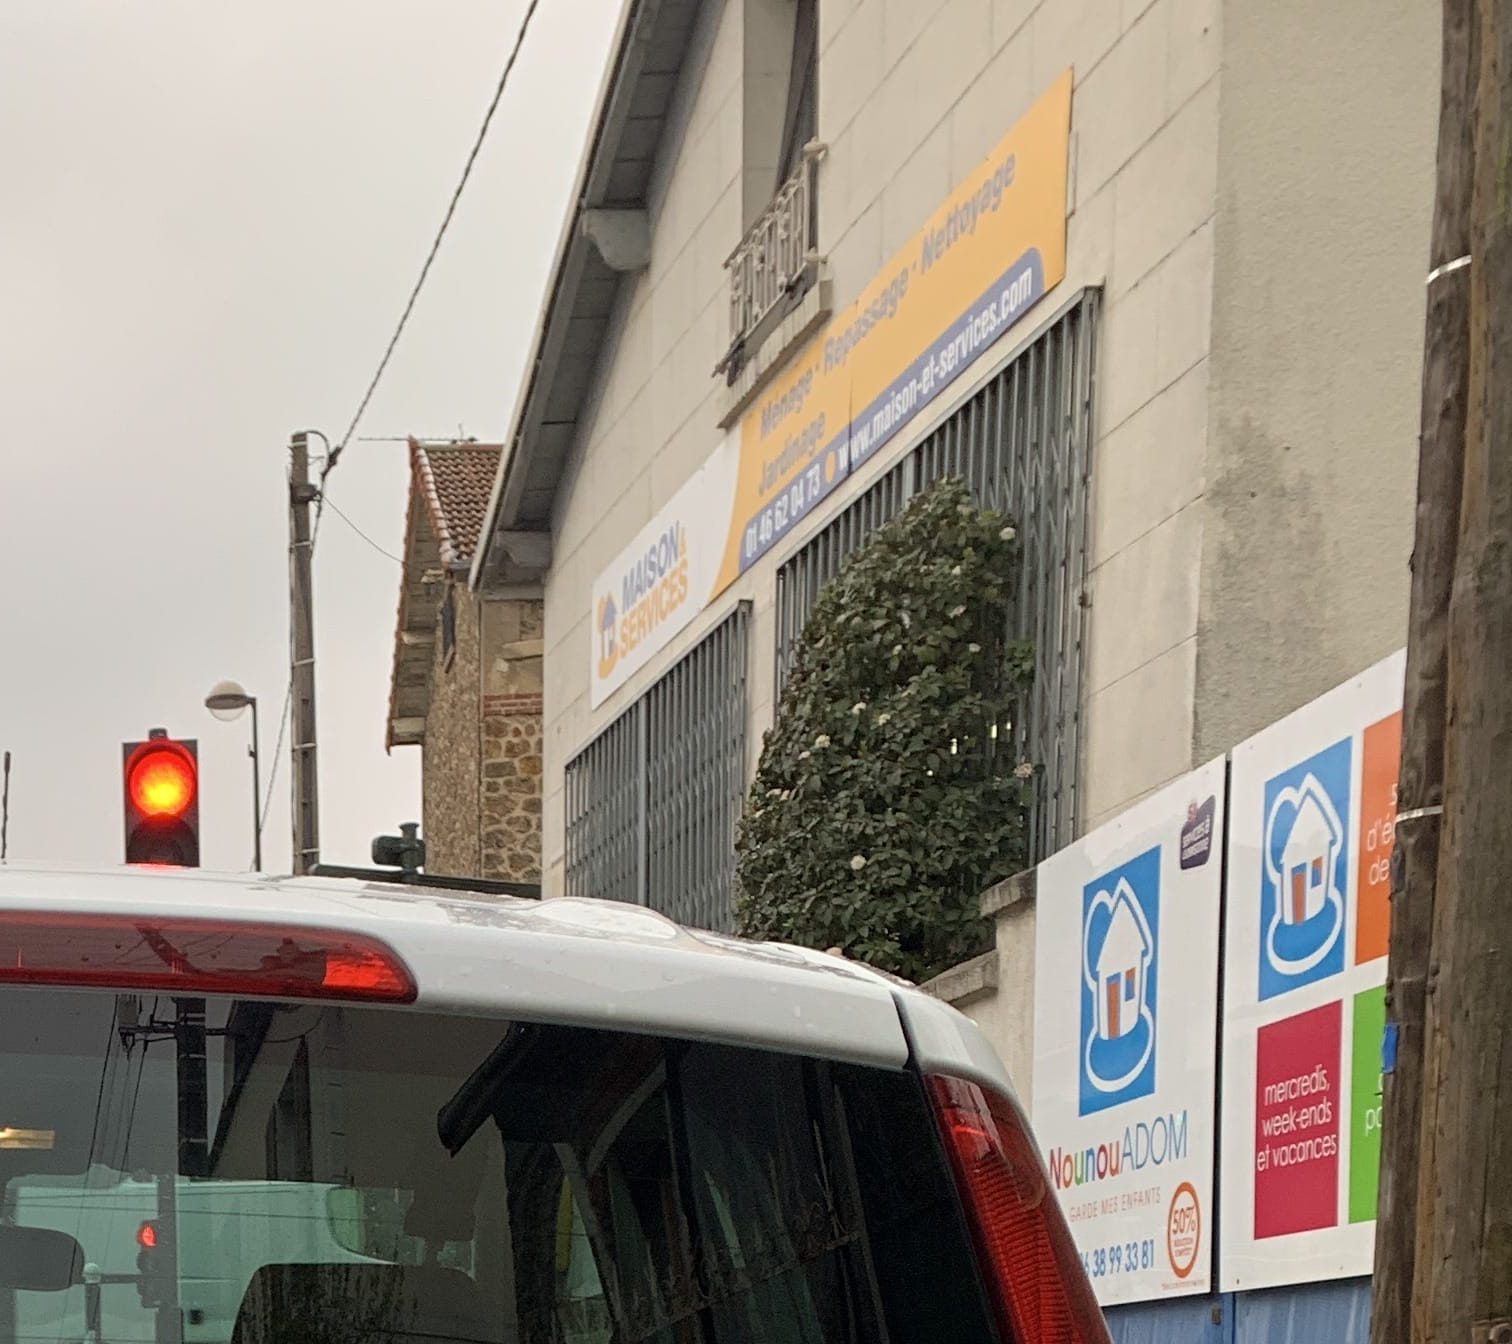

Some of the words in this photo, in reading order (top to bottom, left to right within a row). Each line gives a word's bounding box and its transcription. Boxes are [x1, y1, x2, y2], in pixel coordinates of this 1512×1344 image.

[823, 267, 909, 375] Repassage
[920, 153, 1016, 275] Nettoyage
[745, 523, 758, 557] 01
[759, 508, 773, 544] 46
[775, 493, 788, 531] 62
[791, 479, 804, 516] 04
[807, 463, 820, 498] 73
[838, 267, 1033, 471] www.maison-et-services.com
[758, 411, 825, 496] Jardinage
[622, 520, 680, 614] MAISON
[619, 559, 688, 659] SERVICES
[1264, 1063, 1330, 1106] mercredis,
[1262, 1096, 1332, 1137] week-ends
[1050, 1110, 1187, 1190] NounouADOM
[1257, 1144, 1269, 1171] et
[1272, 1134, 1336, 1167] vacances
[1070, 1200, 1098, 1222] GARDE
[1101, 1195, 1119, 1215] MES
[1121, 1186, 1161, 1212] ENFANTS
[1172, 1206, 1195, 1236] 50%
[1093, 1247, 1106, 1278] 38
[1109, 1244, 1123, 1275] 99
[1125, 1241, 1138, 1273] 33
[1142, 1238, 1155, 1270] 81
